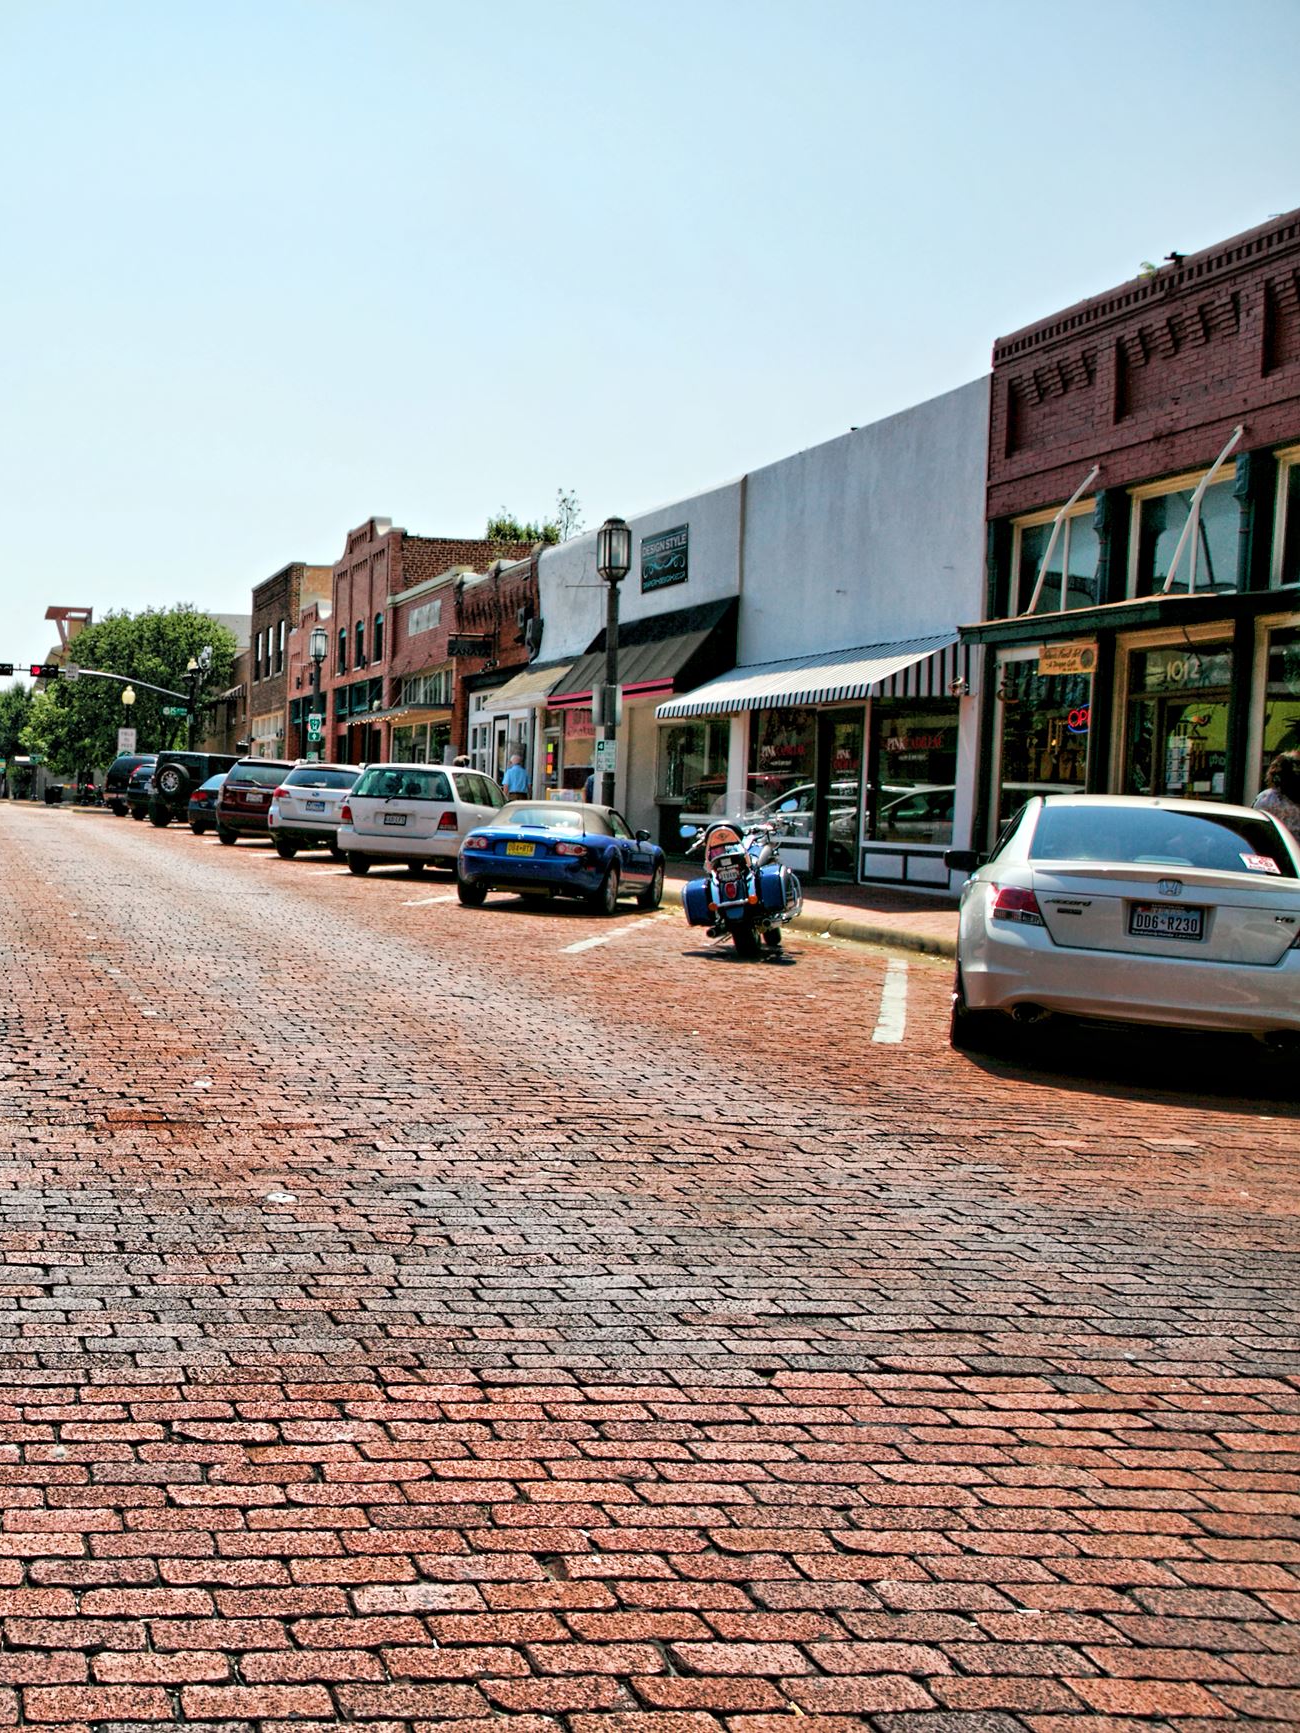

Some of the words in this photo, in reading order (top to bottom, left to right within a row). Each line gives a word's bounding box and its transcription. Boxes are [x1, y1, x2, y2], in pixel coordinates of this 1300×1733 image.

[642, 541, 666, 557] DESIGN
[666, 533, 687, 549] STYLE
[1166, 657, 1201, 681] 1012
[887, 737, 905, 750] PINK
[1044, 898, 1093, 907] Accord
[1136, 914, 1159, 929] DD6
[1167, 917, 1198, 933] R230
[1275, 915, 1295, 923] V6
